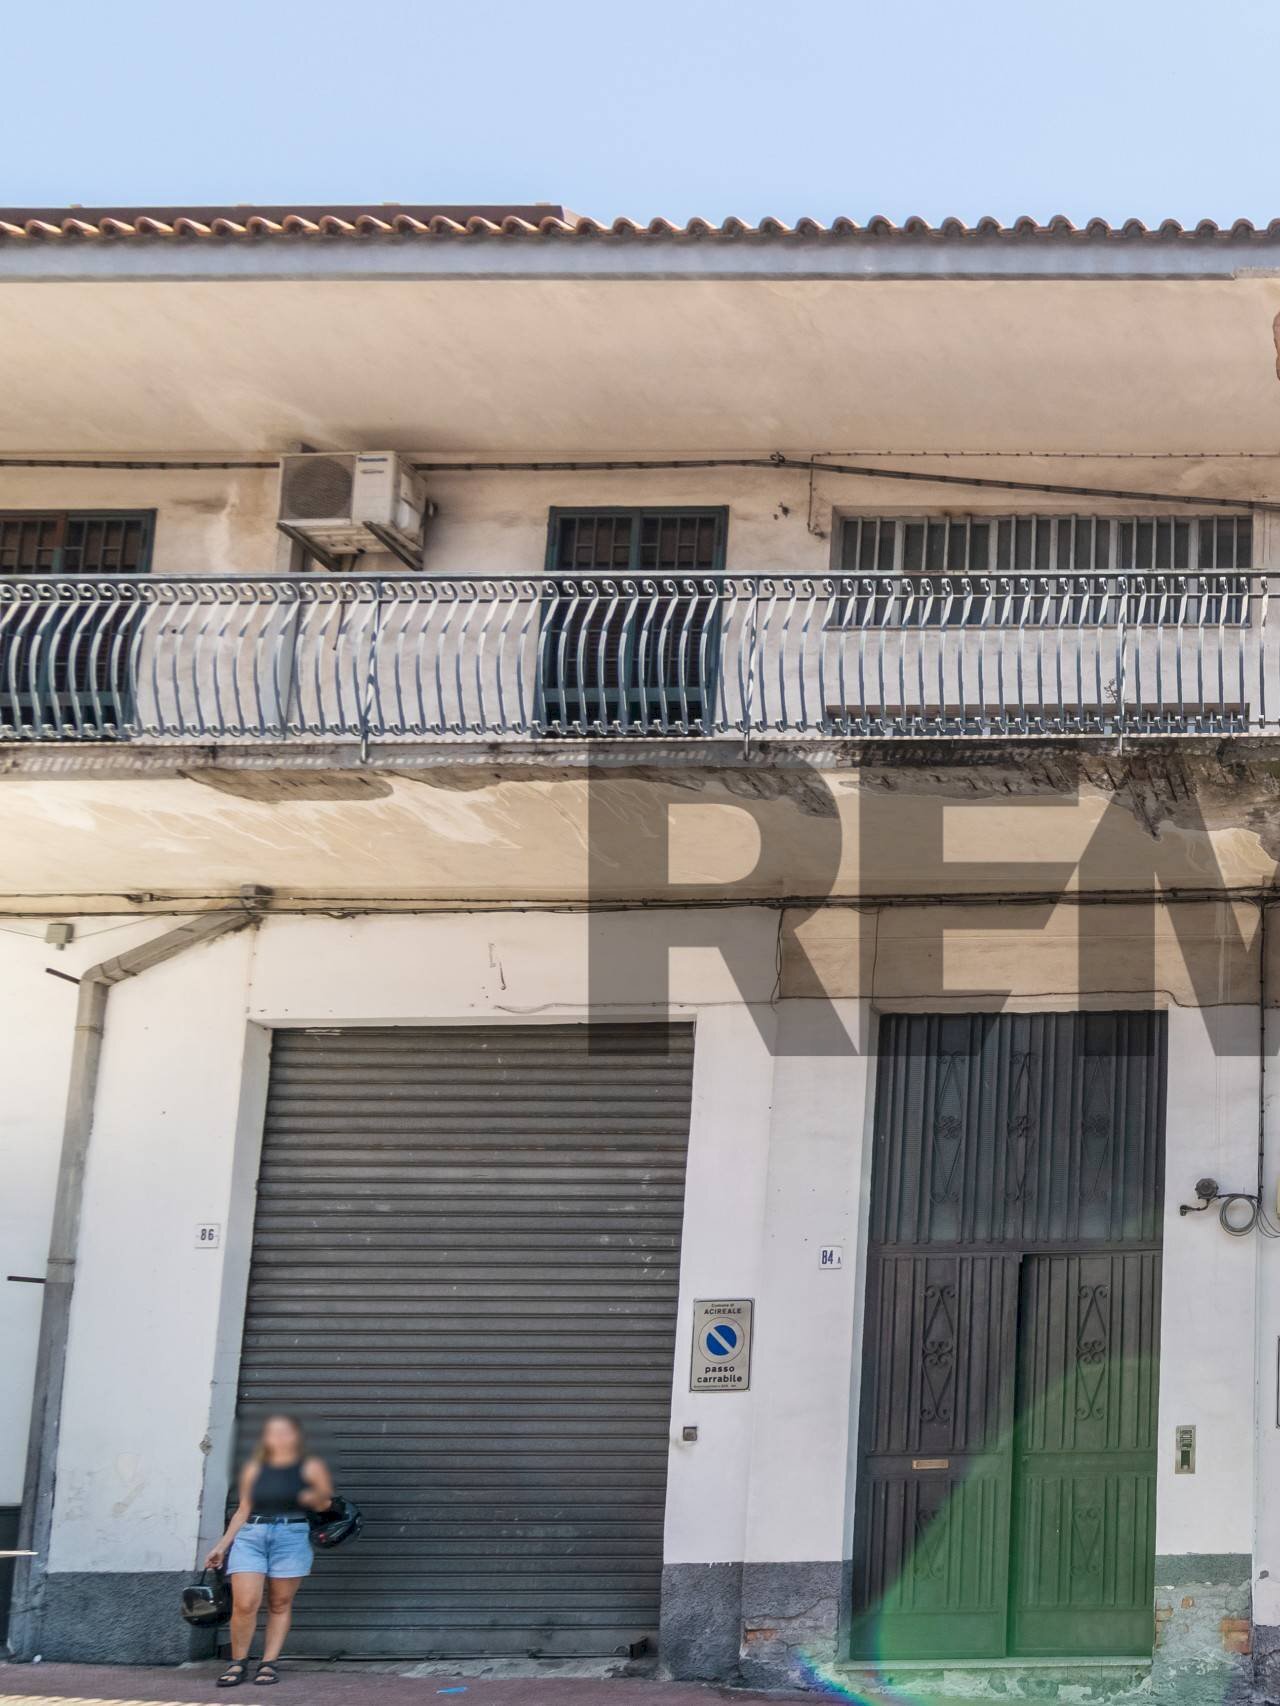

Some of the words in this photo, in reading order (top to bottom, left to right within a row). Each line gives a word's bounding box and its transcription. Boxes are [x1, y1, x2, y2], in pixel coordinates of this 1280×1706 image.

[200, 1228, 214, 1241] 86
[821, 1250, 833, 1264] 84
[705, 1366, 735, 1374] passo
[697, 1374, 742, 1383] carrabile
